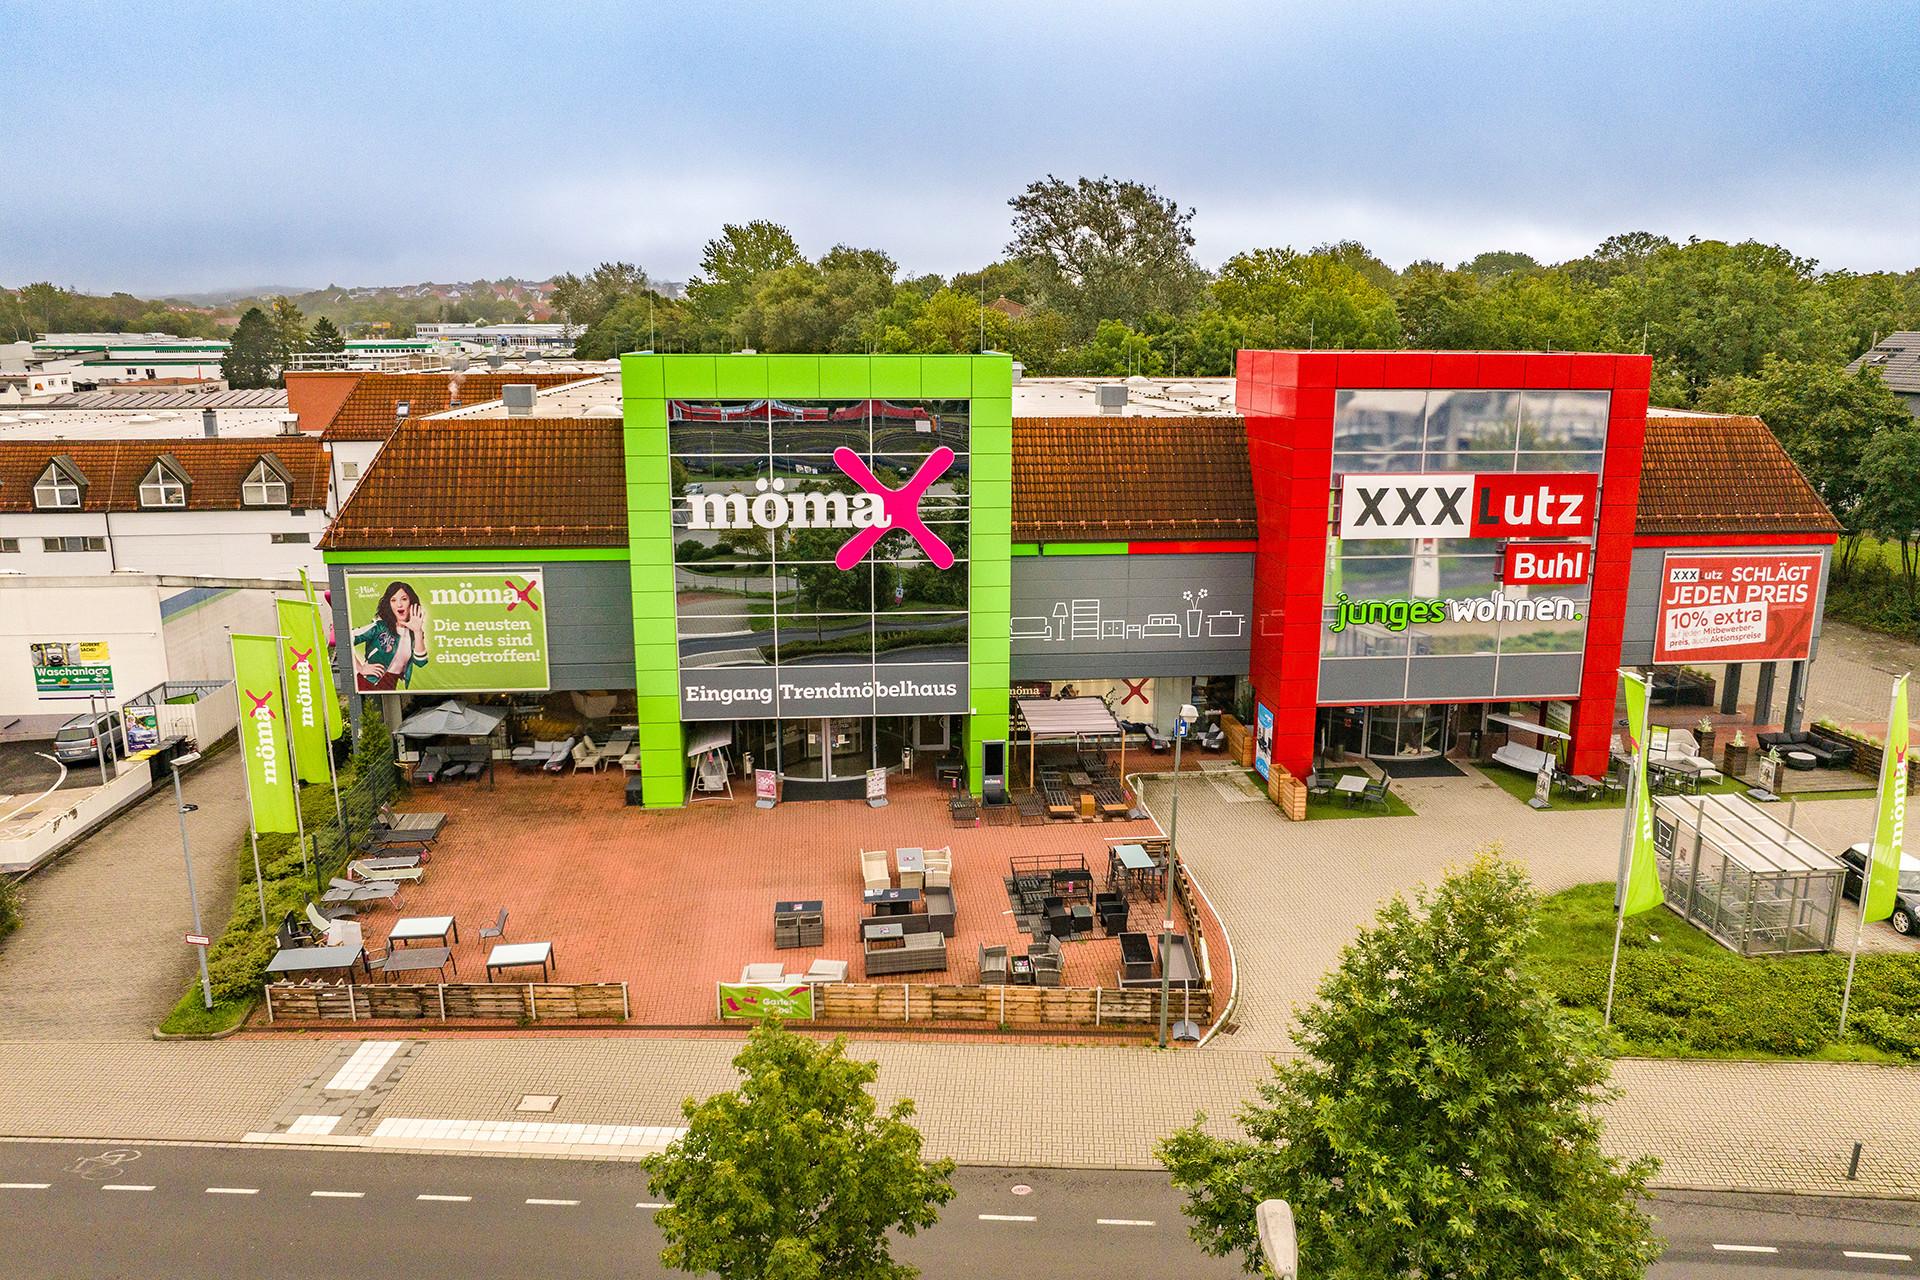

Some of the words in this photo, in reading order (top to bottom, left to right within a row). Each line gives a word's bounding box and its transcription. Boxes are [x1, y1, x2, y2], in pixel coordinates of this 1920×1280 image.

[1513, 552, 1583, 579] Buhl
[1731, 562, 1812, 582] SCHLÄGT
[1666, 585, 1739, 605] JEDEN
[1746, 584, 1808, 604] PREIS
[1329, 591, 1446, 632] junges
[1446, 590, 1583, 623] wohnen.
[1671, 611, 1708, 630] 10%
[1714, 608, 1762, 626] extra
[433, 619, 460, 632] Die
[464, 619, 532, 632] neusten
[1703, 625, 1754, 635] Mitbewerber-
[434, 635, 493, 648] Trends
[497, 634, 533, 647] sind
[1710, 632, 1762, 643] Aktionspreise
[436, 650, 541, 666] eingetroffen!
[36, 667, 109, 679] Waschanlage
[685, 686, 773, 705] Eingang
[779, 680, 957, 700] Trendmöbelhaus
